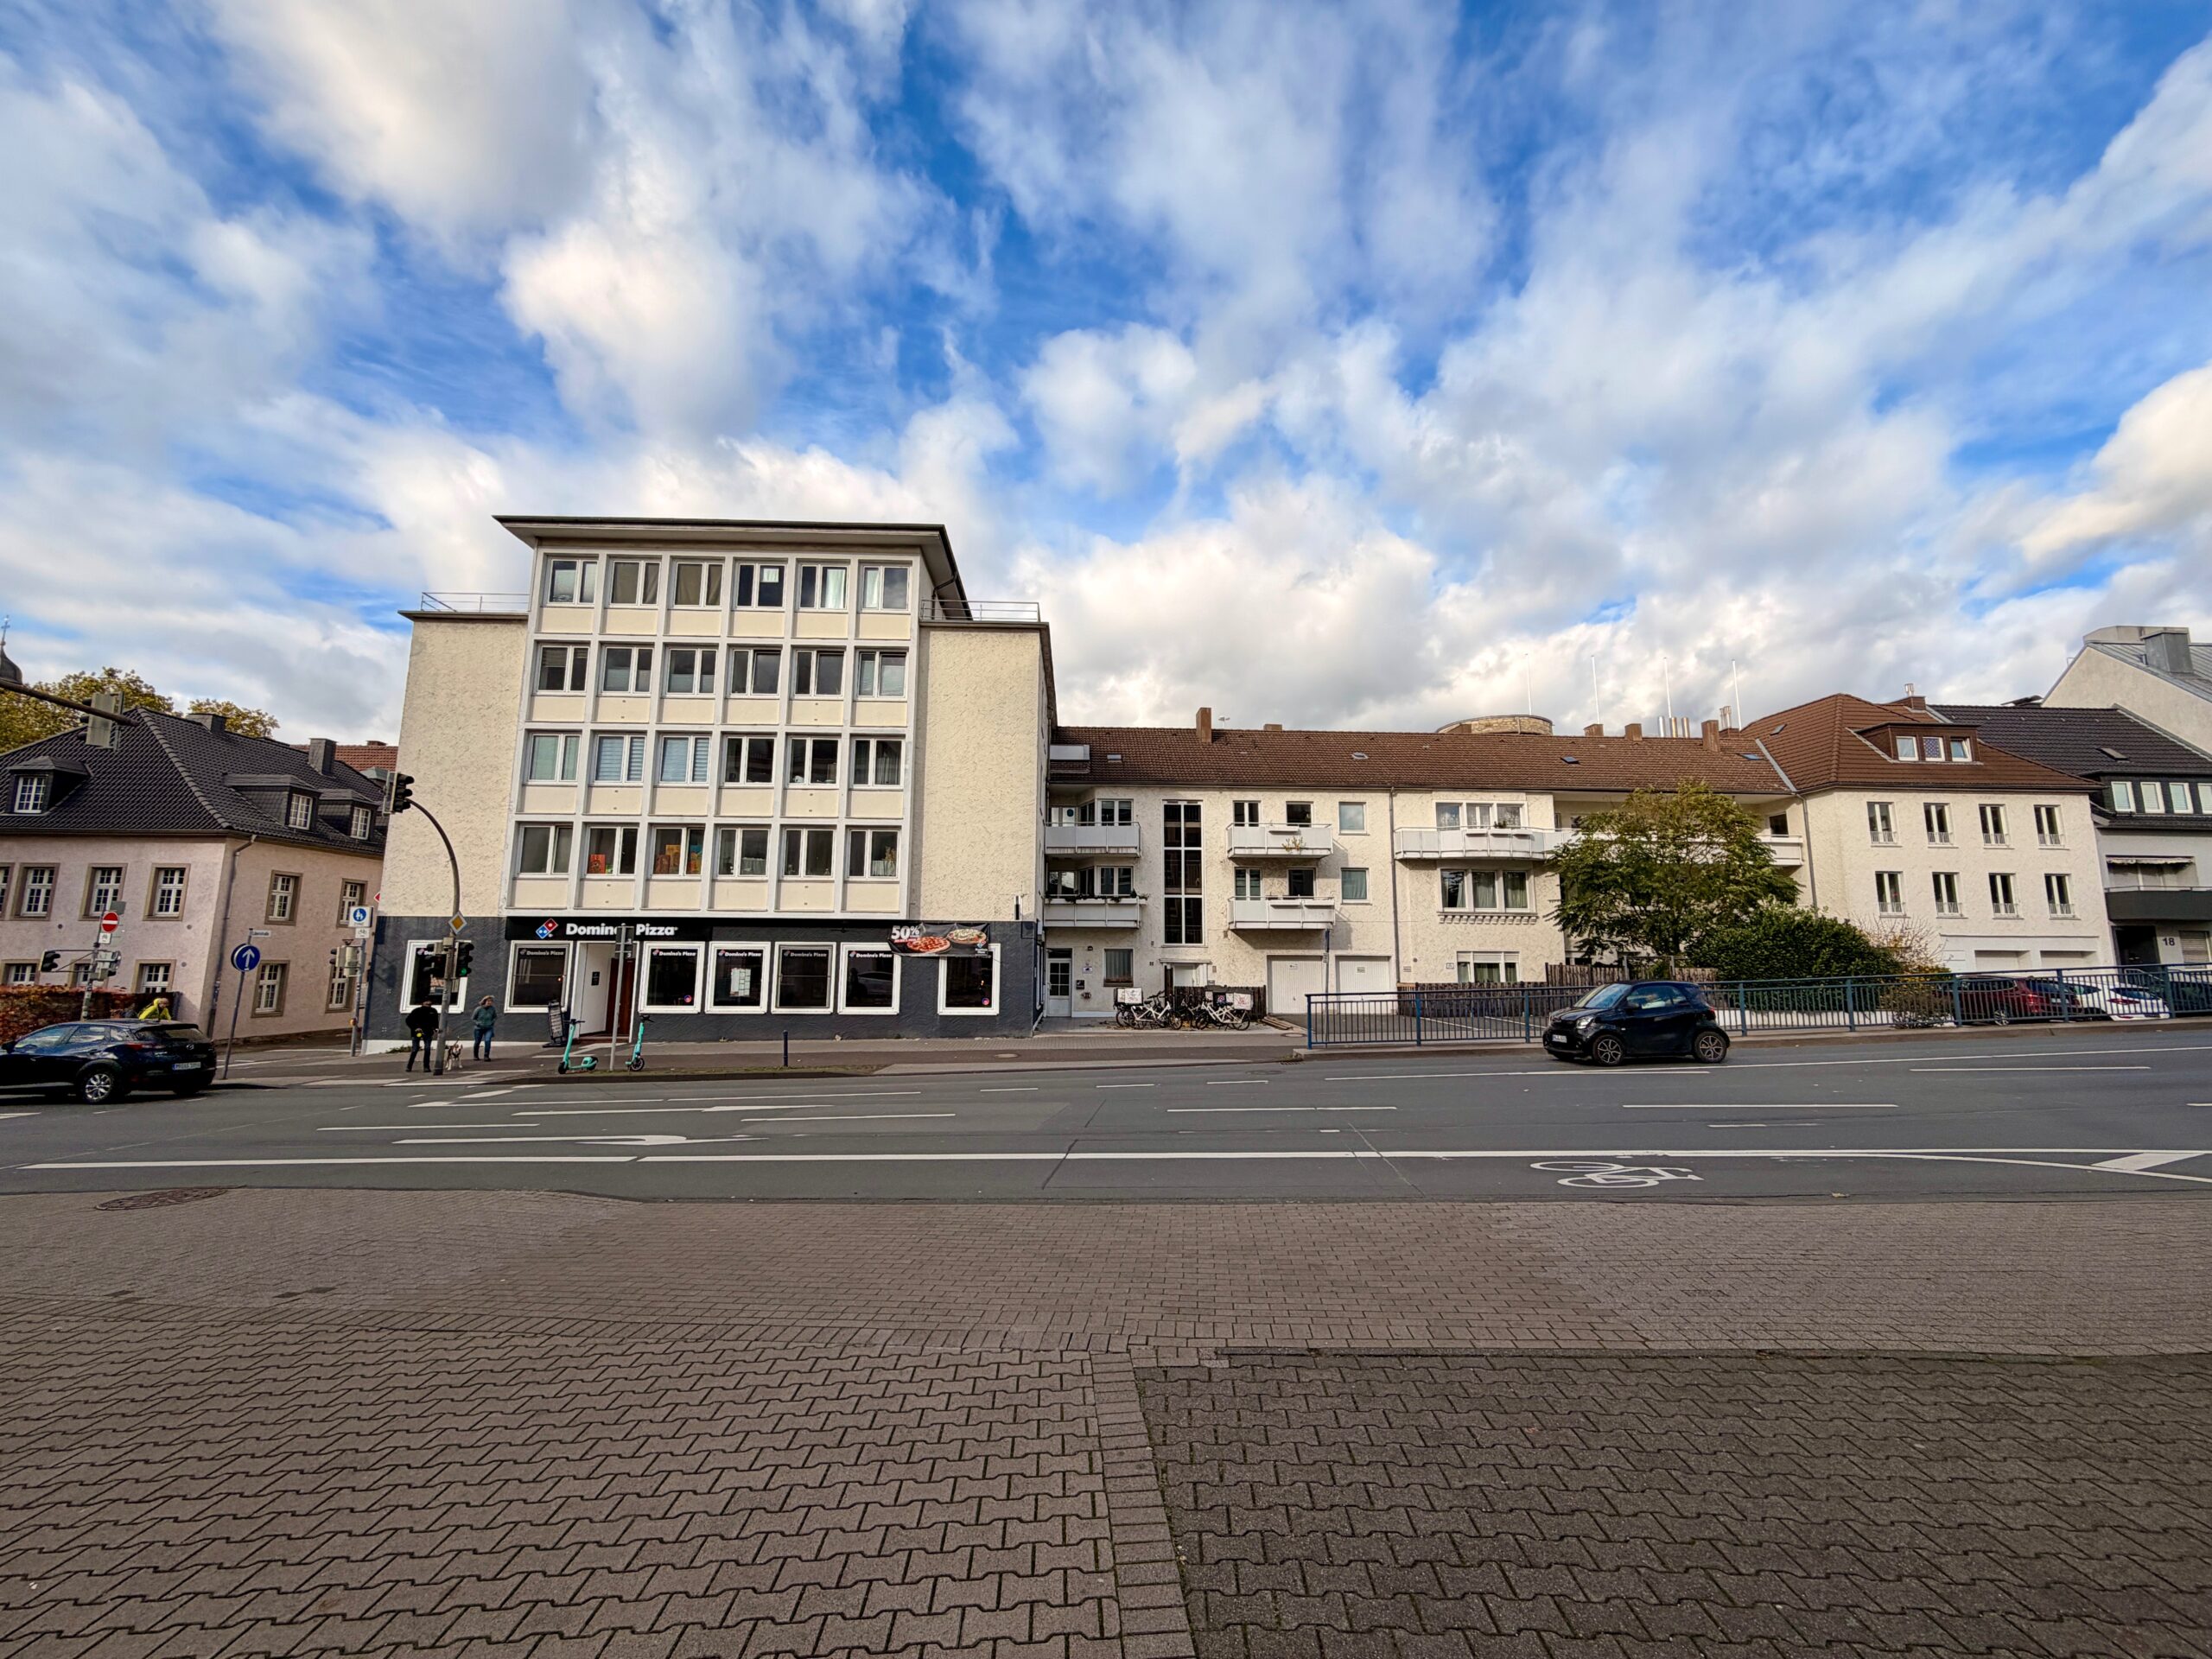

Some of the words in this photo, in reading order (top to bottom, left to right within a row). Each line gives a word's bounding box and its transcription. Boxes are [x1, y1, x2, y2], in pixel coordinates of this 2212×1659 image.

[566, 923, 617, 936] Domin
[635, 923, 675, 936] Pizza
[891, 925, 920, 940] 50%
[2163, 937, 2175, 946] 18
